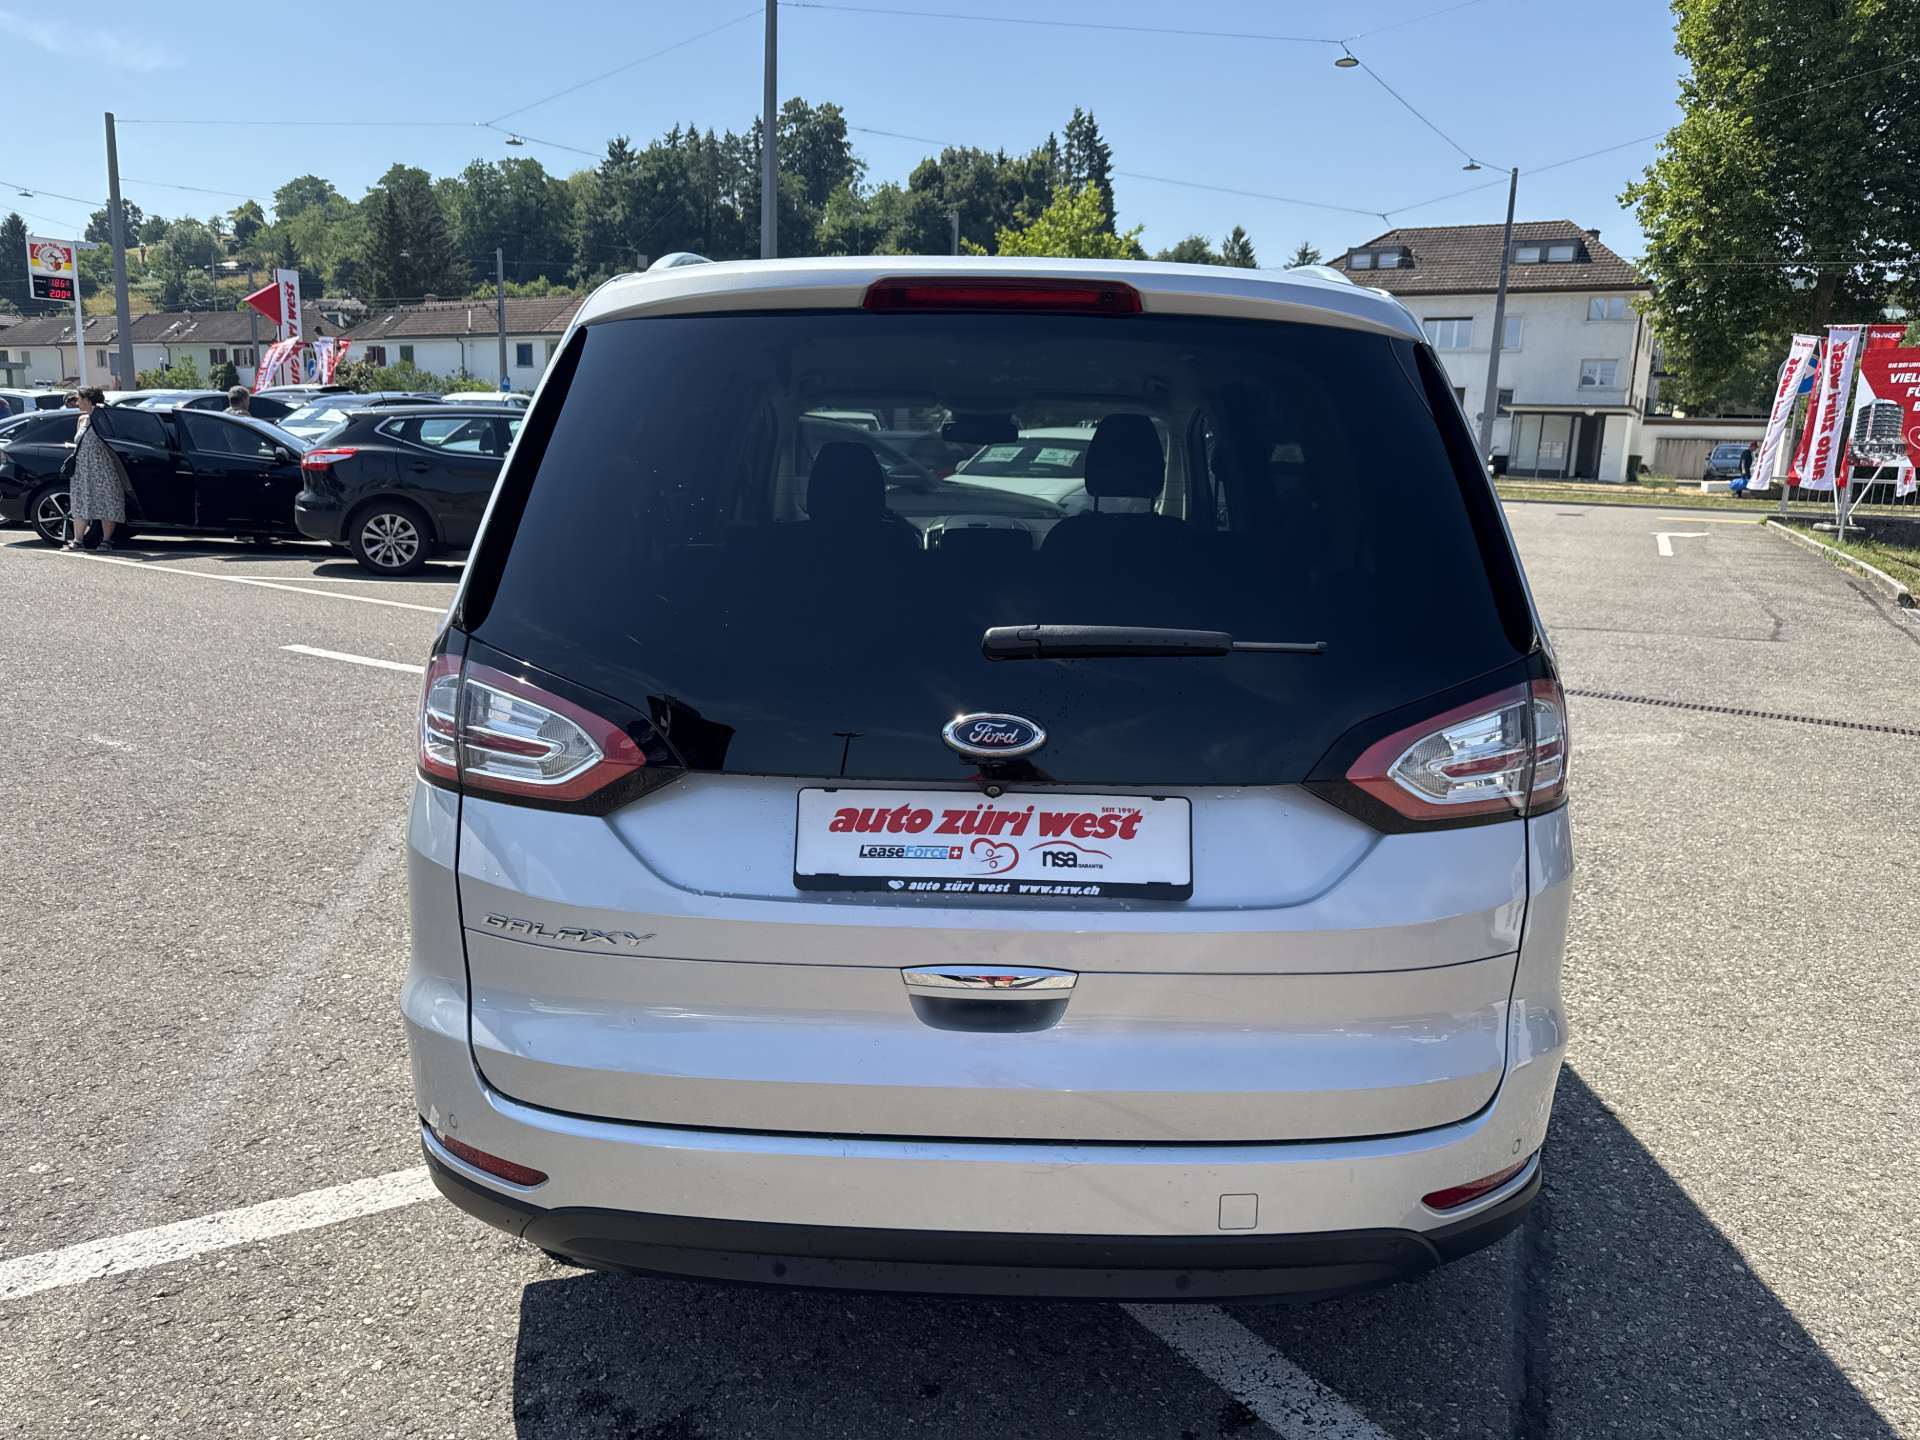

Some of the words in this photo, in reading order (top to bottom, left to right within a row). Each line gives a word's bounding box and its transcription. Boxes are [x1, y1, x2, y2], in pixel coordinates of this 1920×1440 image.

[284, 281, 297, 320] west
[1890, 373, 1920, 384] VIEL
[969, 722, 1019, 744] Ford
[828, 803, 934, 833] auto
[933, 803, 1035, 836] züri
[1039, 808, 1144, 840] west
[859, 844, 949, 859] LeaseForce
[1042, 850, 1078, 868] nsa
[908, 882, 941, 891] auto
[943, 880, 973, 891] züri
[978, 882, 1011, 893] west
[1019, 884, 1101, 896] www.azw.ch
[481, 912, 657, 946] GALAXY
